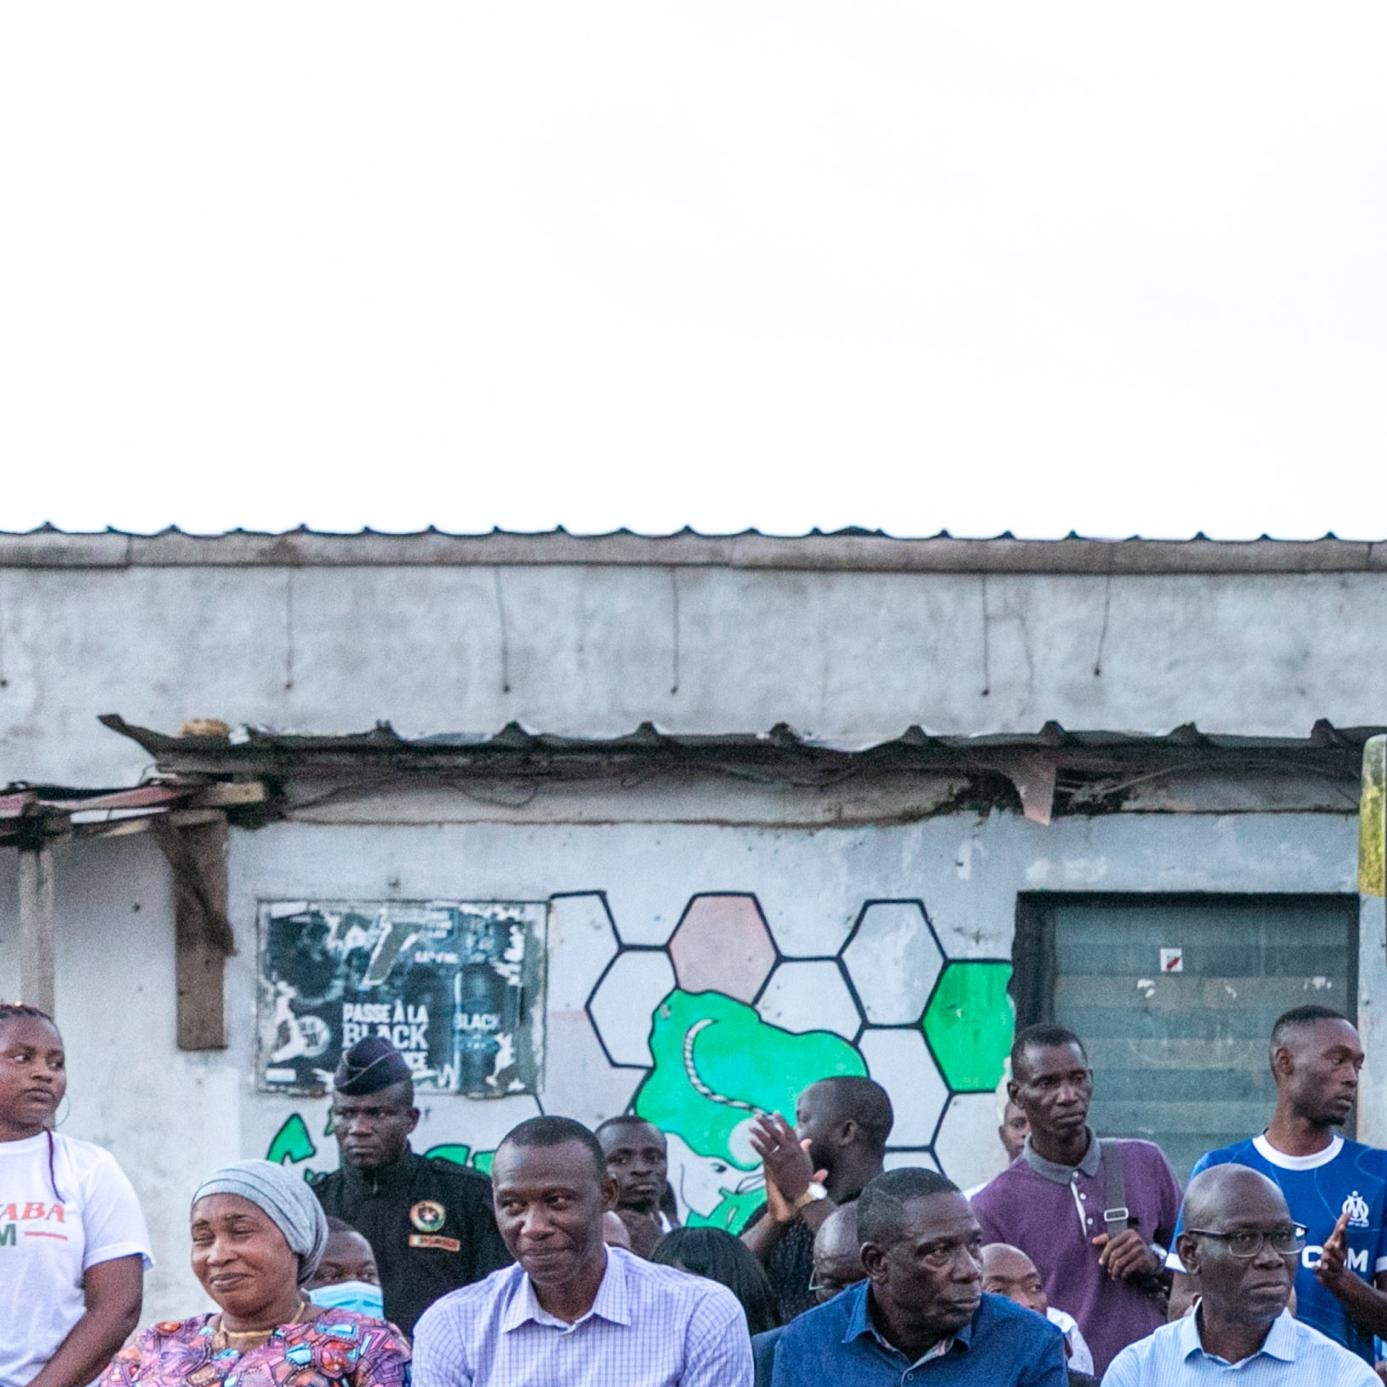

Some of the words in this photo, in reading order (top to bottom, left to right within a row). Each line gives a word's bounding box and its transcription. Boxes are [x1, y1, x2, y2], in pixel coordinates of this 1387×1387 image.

[342, 1002, 392, 1023] PASSE
[407, 1004, 430, 1024] LA
[0, 1201, 65, 1224] ABA
[1302, 1245, 1369, 1273] CM
